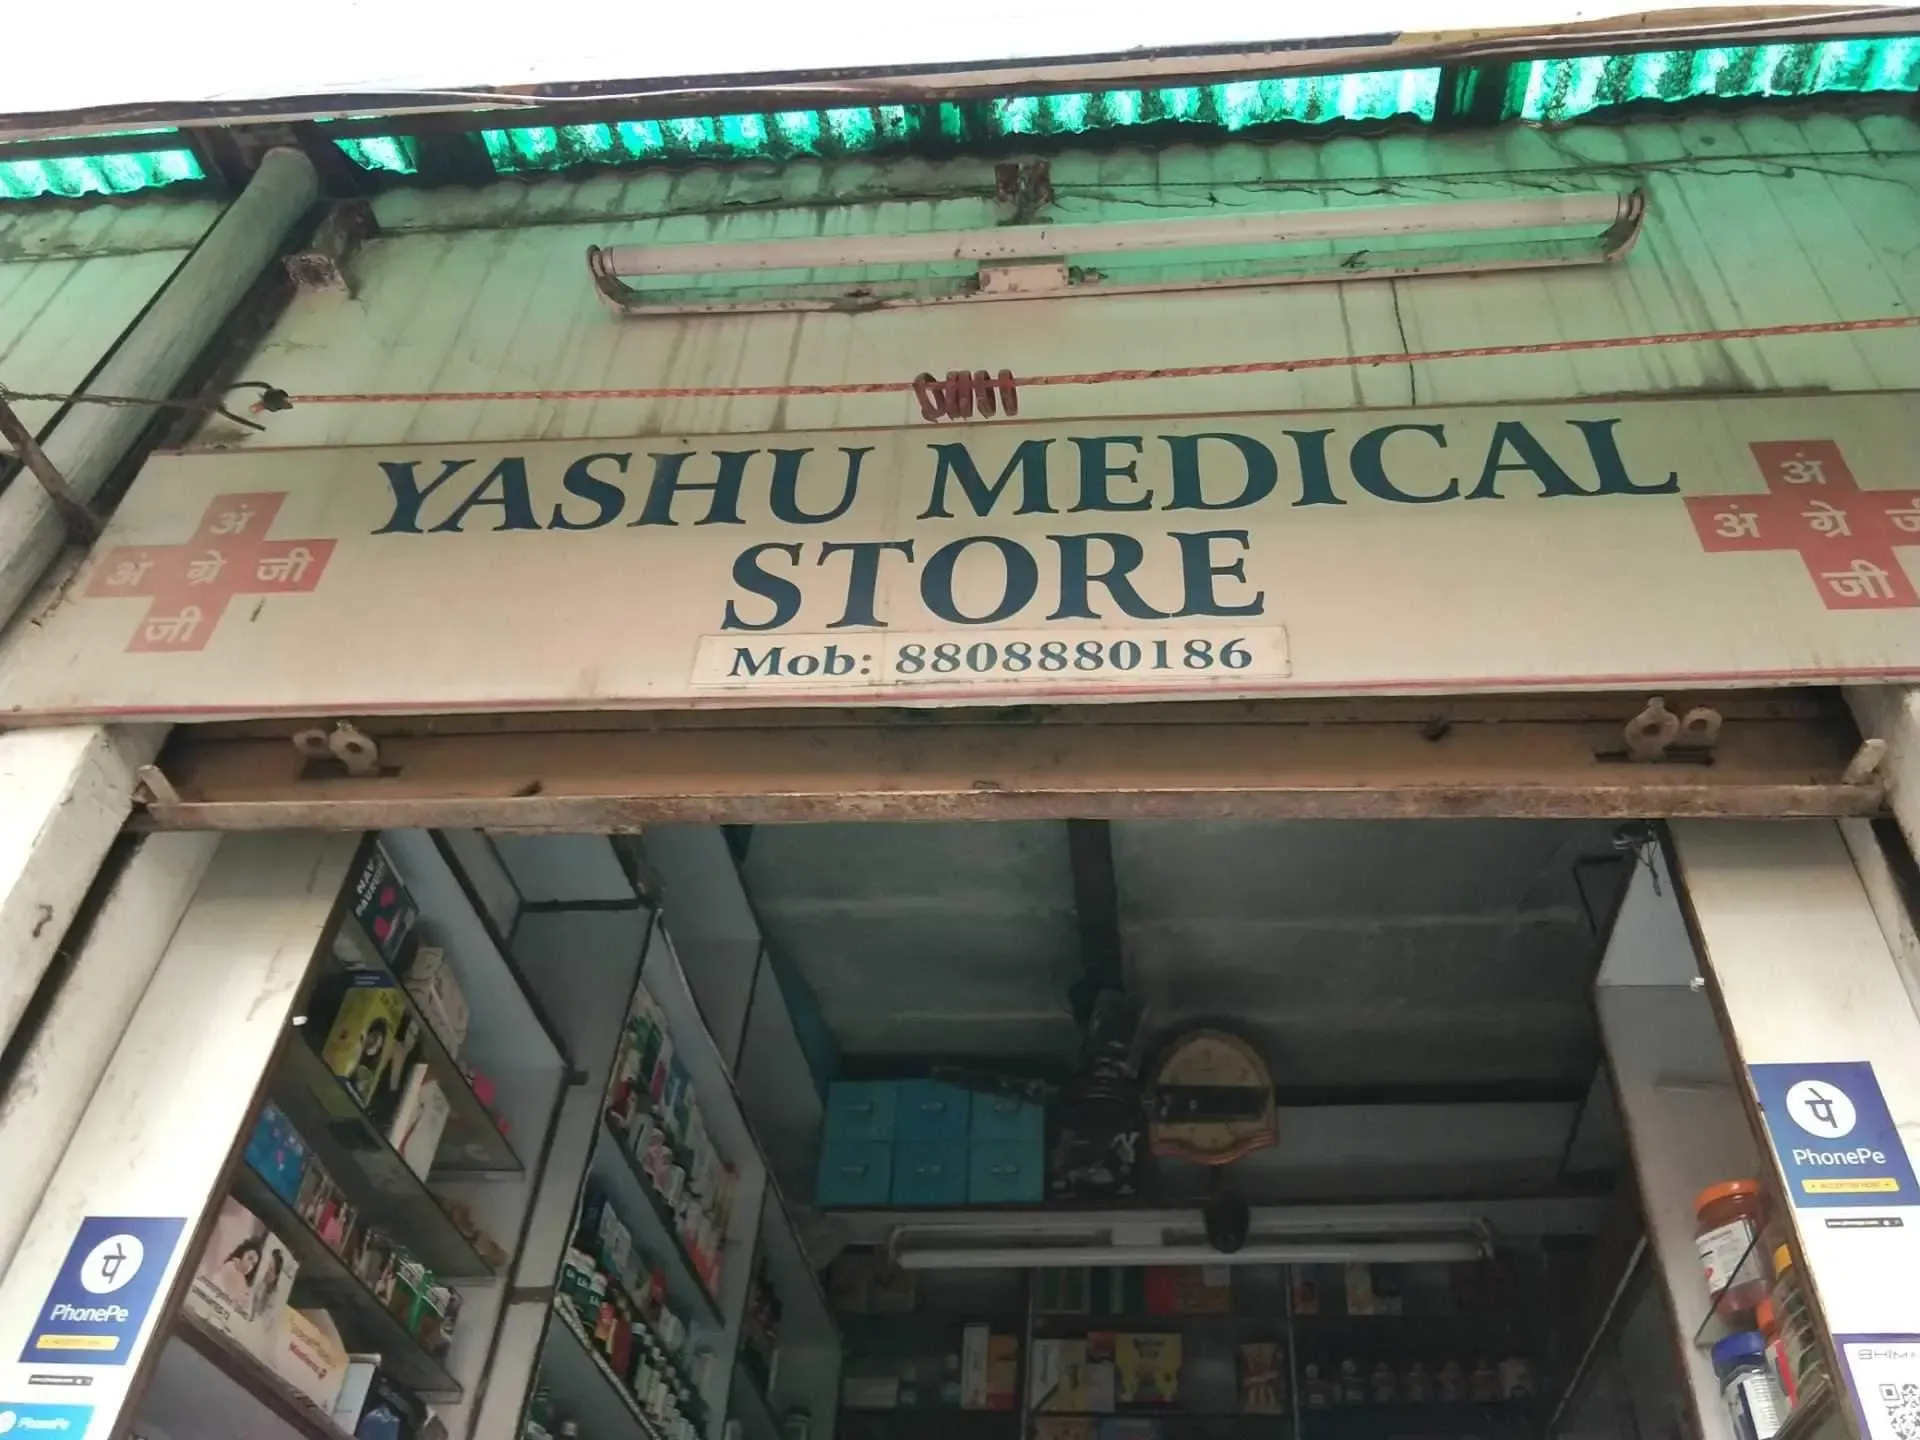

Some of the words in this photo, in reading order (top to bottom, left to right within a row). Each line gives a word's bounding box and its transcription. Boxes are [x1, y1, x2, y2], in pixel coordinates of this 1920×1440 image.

[371, 447, 875, 534] YASHU
[915, 417, 1680, 519] MEDICAL
[720, 529, 1265, 631] STORE
[727, 645, 872, 677] Mob:
[895, 637, 1252, 674] 8808880186
[1792, 1147, 1887, 1166] PhonePe
[50, 1304, 129, 1322] PhonePe
